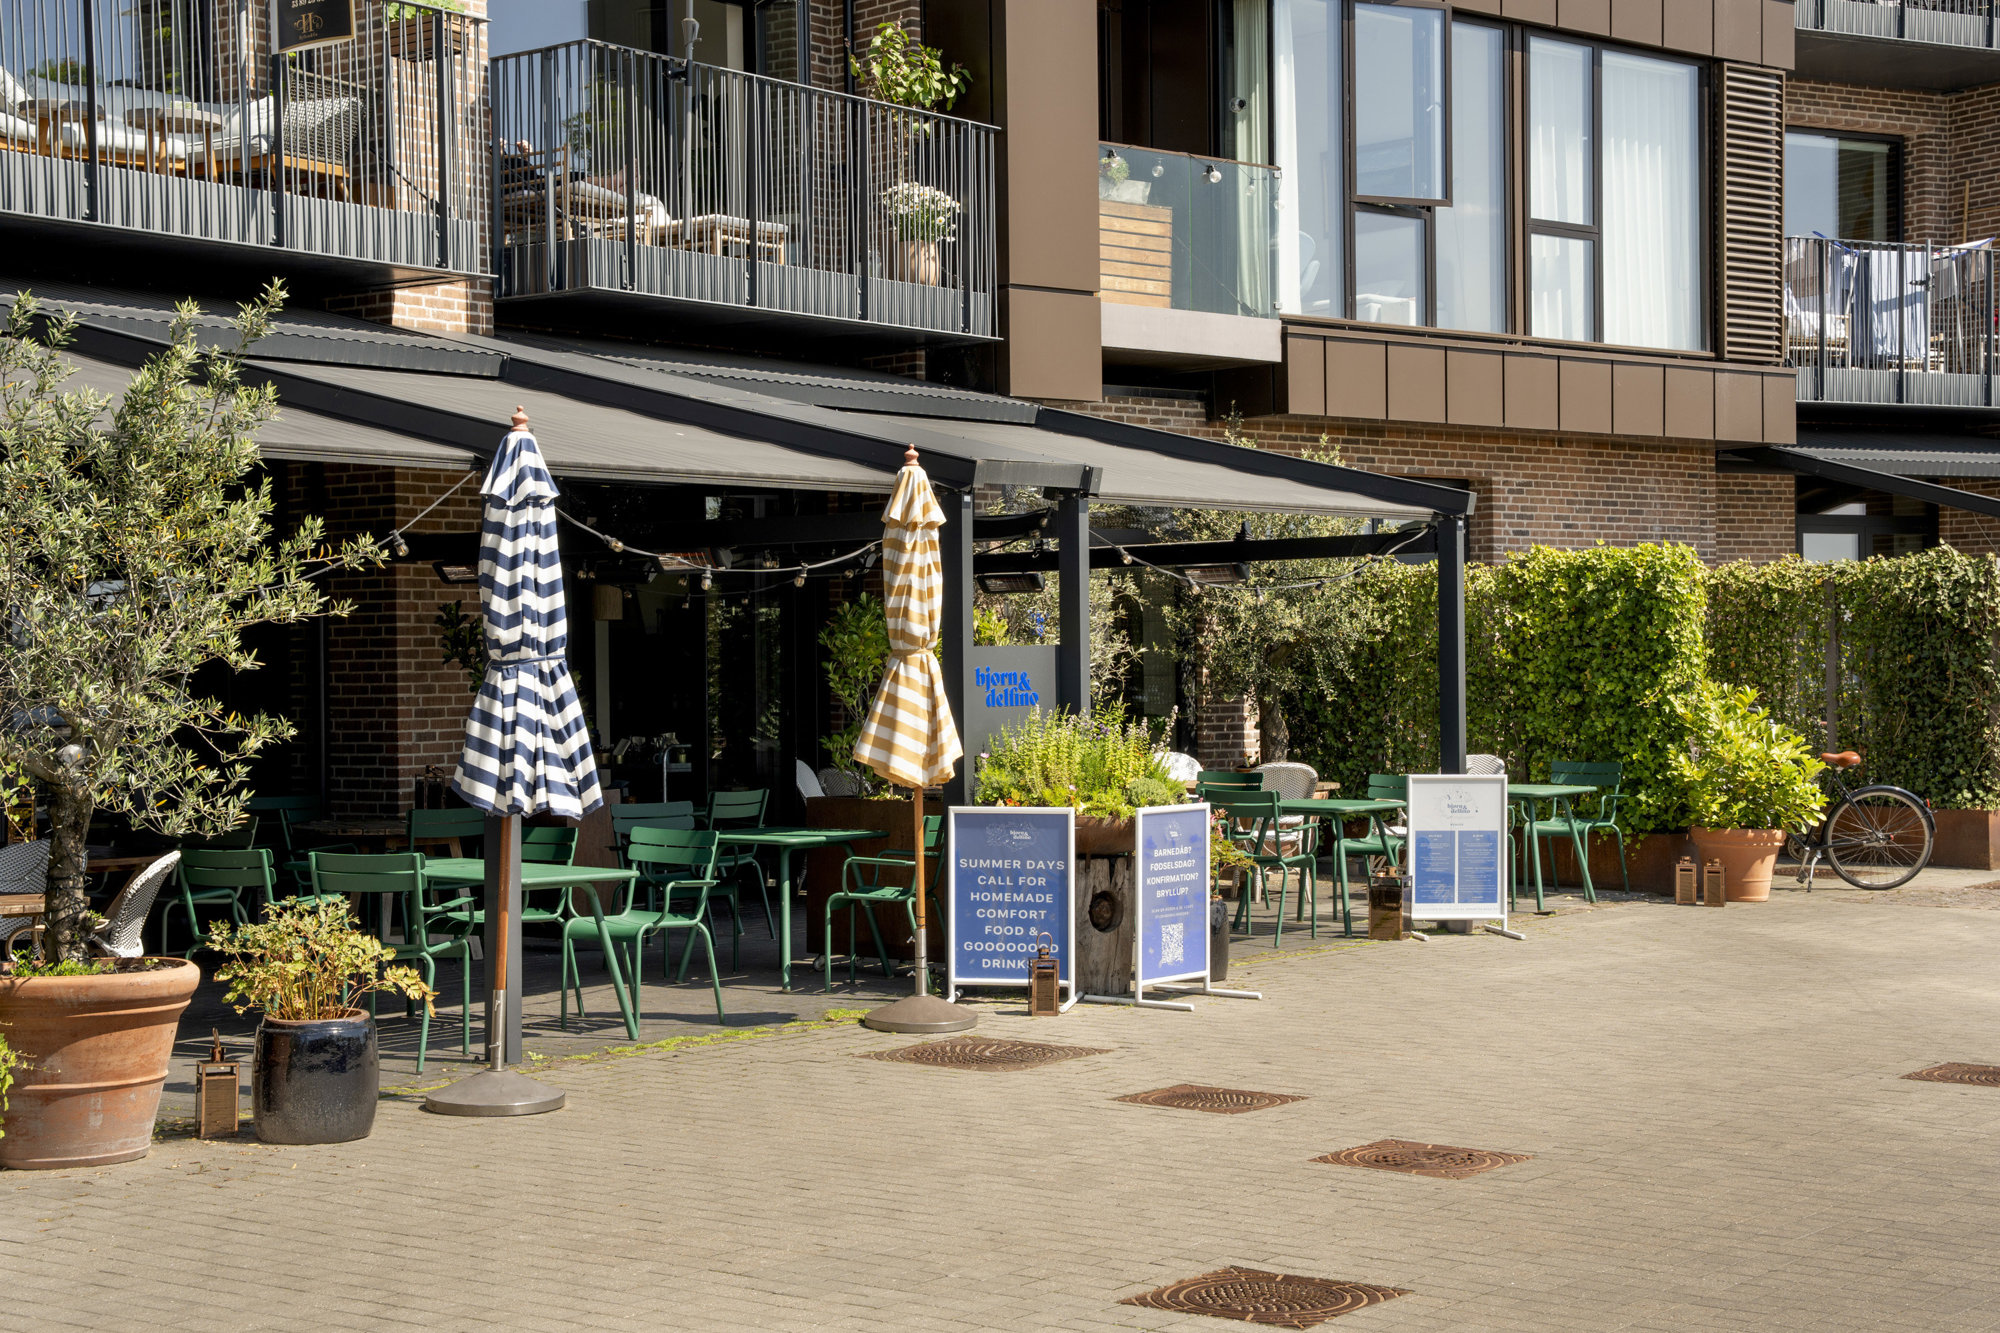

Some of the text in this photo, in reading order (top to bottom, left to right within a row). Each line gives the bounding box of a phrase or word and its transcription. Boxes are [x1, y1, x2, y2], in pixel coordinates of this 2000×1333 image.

[985, 686, 1039, 708] delfino
[1153, 844, 1192, 857] BARNEDÅB?
[959, 858, 1065, 870] SUMMER DAYS
[977, 875, 1047, 886] CALL FOR
[1146, 872, 1199, 886] KONFIRMATION?
[970, 892, 1054, 903] HOMEMADE
[1156, 887, 1189, 898] BRYLLUP?
[976, 908, 1047, 919] COMFORT
[984, 925, 1038, 936] FOOD &
